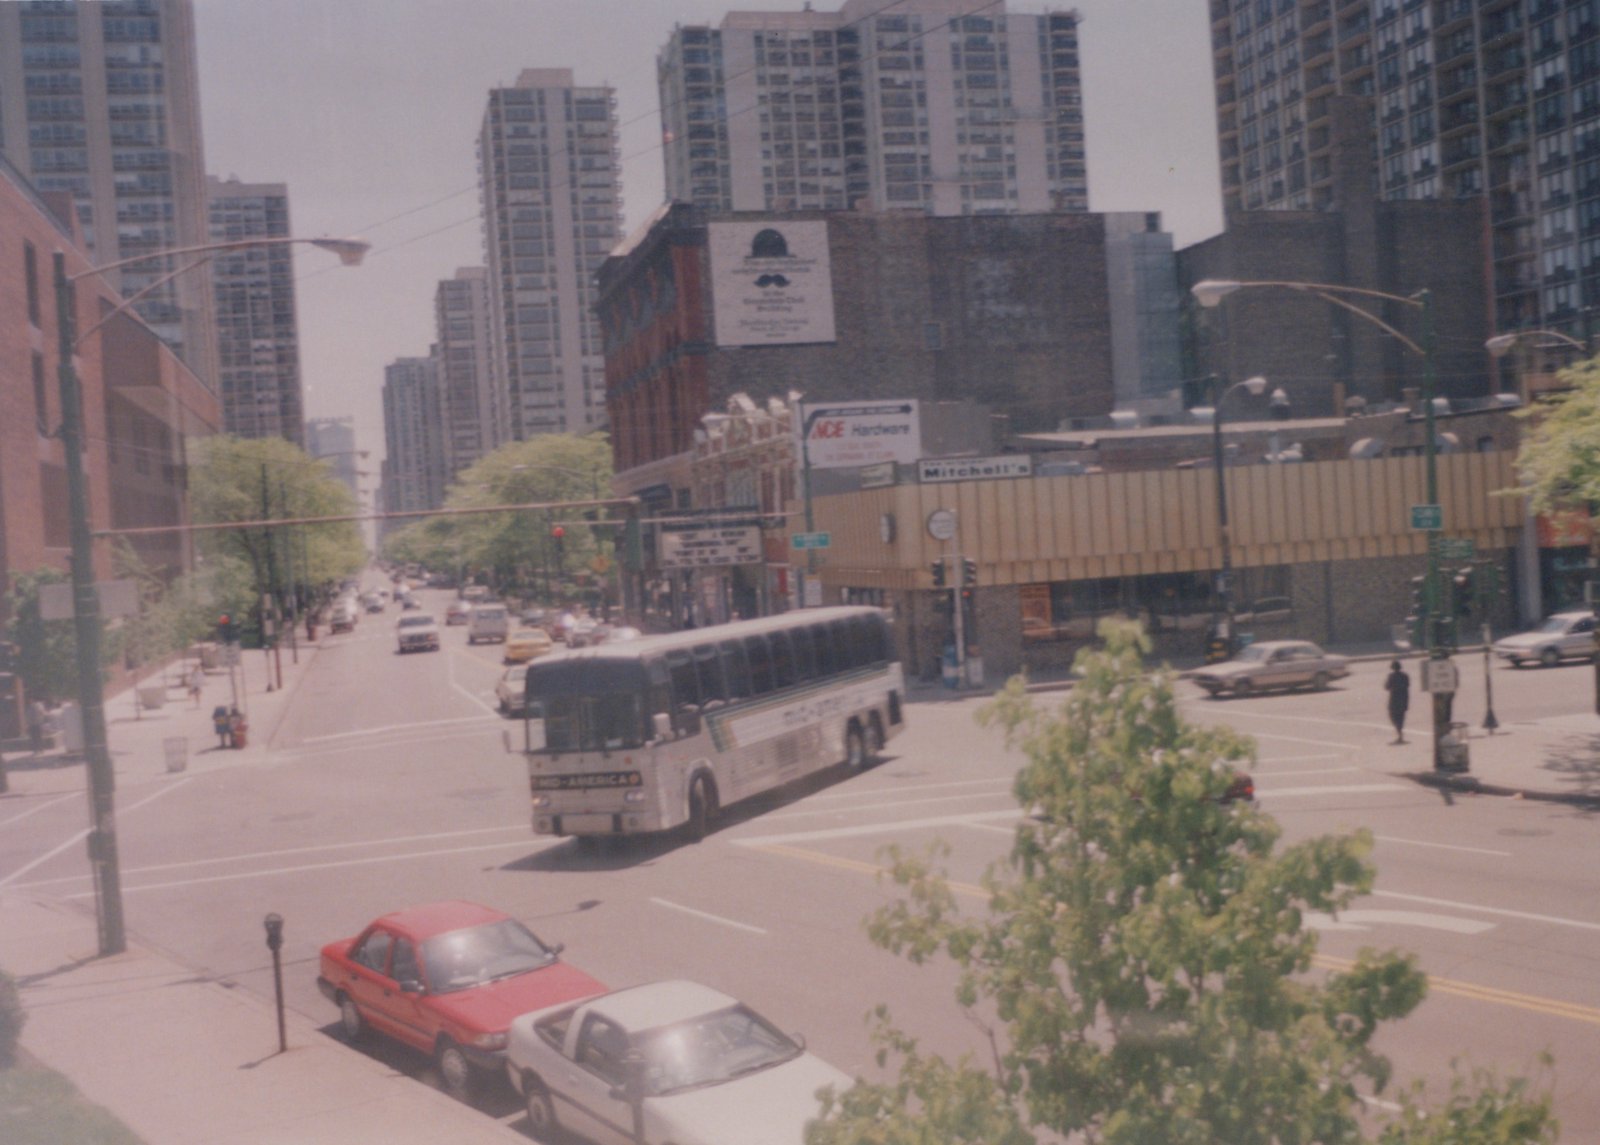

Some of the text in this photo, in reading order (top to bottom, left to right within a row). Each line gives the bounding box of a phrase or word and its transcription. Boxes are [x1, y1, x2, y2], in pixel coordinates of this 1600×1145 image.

[811, 421, 910, 439] ACE Hardware
[924, 464, 1028, 478] Mitchell's
